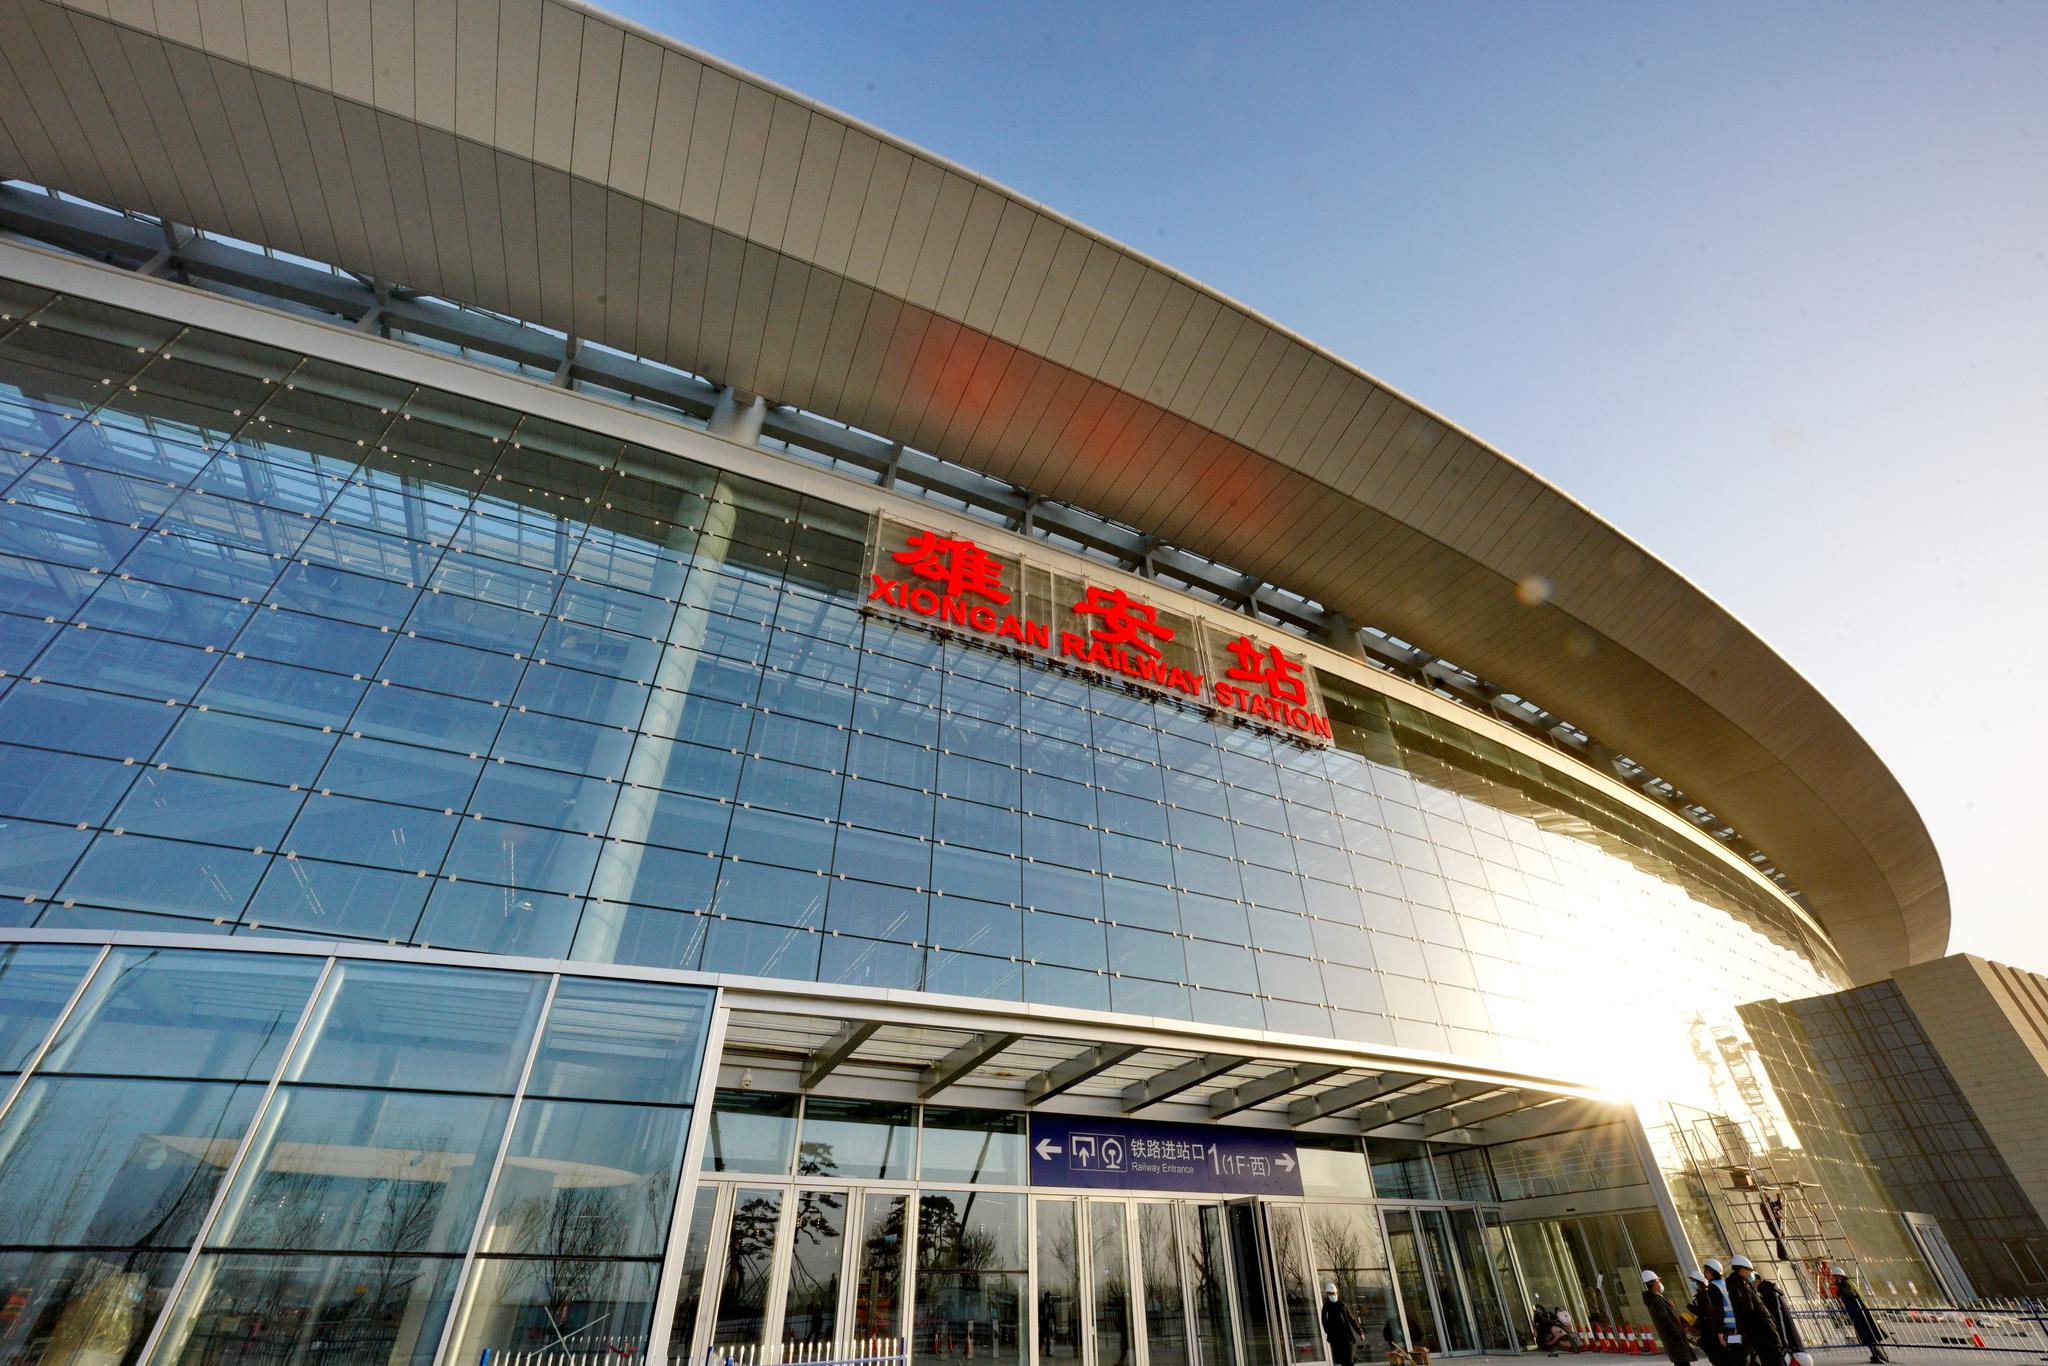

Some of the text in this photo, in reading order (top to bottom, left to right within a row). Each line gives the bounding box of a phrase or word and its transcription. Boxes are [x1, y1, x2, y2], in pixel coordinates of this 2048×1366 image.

[869, 574, 1333, 740] XIONGAN RAILWAY STATION
[891, 530, 1306, 706] 雄安站
[1132, 1162, 1194, 1174] Railway Entrance
